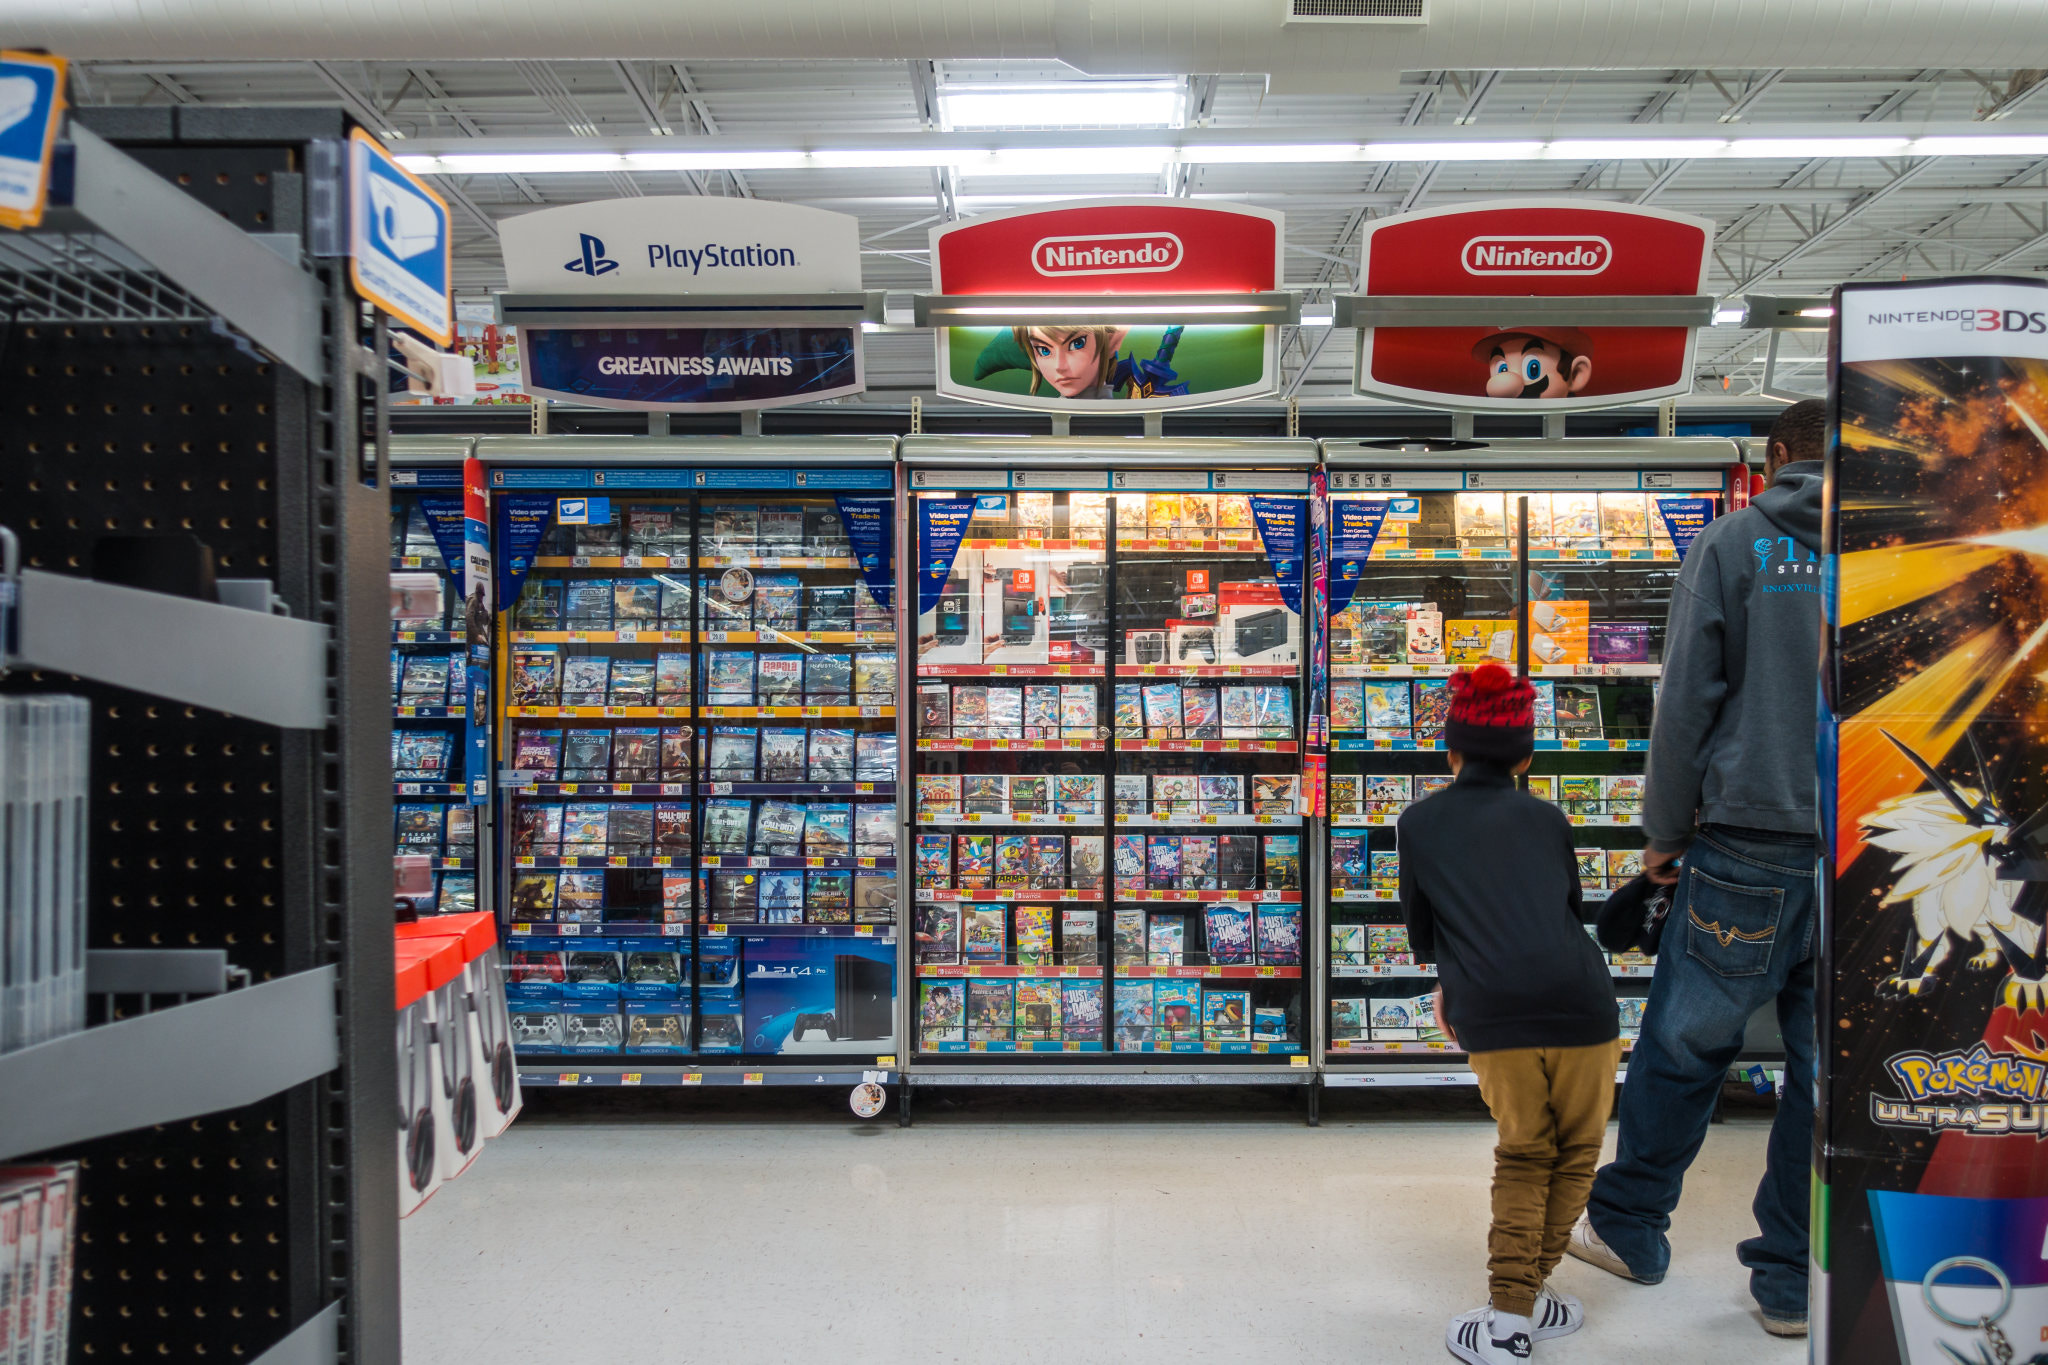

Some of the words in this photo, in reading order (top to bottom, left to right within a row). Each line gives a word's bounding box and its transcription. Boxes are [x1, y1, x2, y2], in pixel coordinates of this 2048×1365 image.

[647, 243, 796, 276] PlayStation
[1045, 243, 1171, 267] Nintendo
[1474, 245, 1599, 267] Nintendo
[1868, 309, 1975, 325] NINTENDO
[1976, 309, 2047, 334] 3DS
[598, 355, 714, 376] GREATNESS
[716, 356, 793, 376] AWAITS
[1256, 511, 1276, 519] Video
[1265, 518, 1295, 526] Trade-In
[1468, 527, 1496, 536] ZELDA
[572, 736, 598, 744] XCOM
[678, 812, 691, 820] DUT
[1114, 849, 1130, 860] JUST
[1152, 845, 1168, 857] JUST
[1116, 856, 1139, 873] DANCE
[998, 875, 1026, 883] ARMS
[664, 882, 692, 897] DiR
[1213, 913, 1233, 928] JUST
[1264, 915, 1284, 929] JUST
[1217, 923, 1244, 944] DANCE
[1267, 926, 1293, 946] DANCE
[773, 966, 812, 976] PS4
[971, 988, 1011, 996] MINECRAFT
[1068, 989, 1088, 1004] JUST
[1071, 1000, 1097, 1020] DANCE
